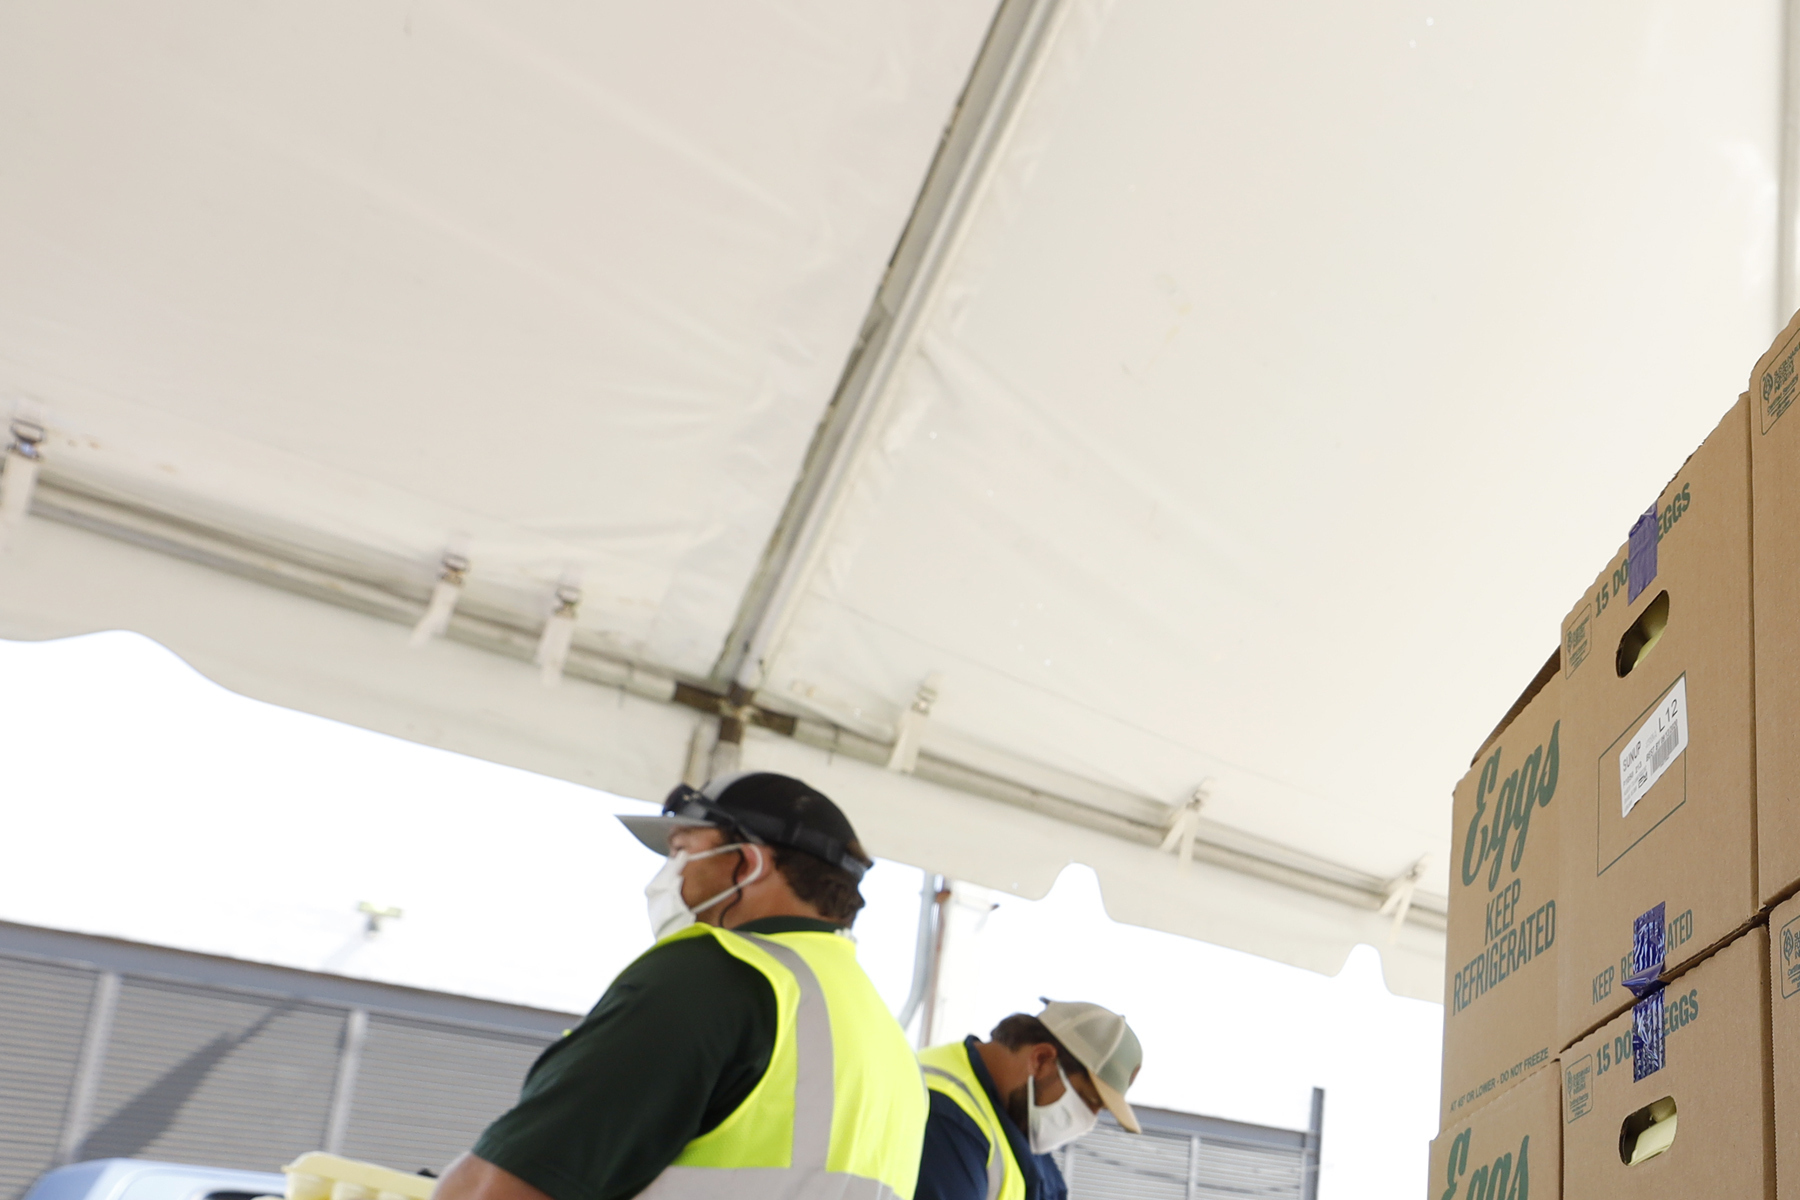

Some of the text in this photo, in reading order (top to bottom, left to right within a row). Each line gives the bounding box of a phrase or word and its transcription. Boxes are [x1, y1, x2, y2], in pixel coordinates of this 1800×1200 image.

[1595, 482, 1691, 618] 15 EGGS
[1461, 719, 1561, 892] Eggs
[1484, 878, 1521, 946] KEEP
[1452, 900, 1556, 1016] REFRIGERATED
[1593, 965, 1614, 1006] KEEP
[1500, 1070, 1510, 1084] DO
[1510, 1061, 1523, 1078] NOT
[1523, 1047, 1549, 1071] FREEZE
[1596, 1042, 1611, 1076] 15
[1664, 989, 1699, 1037] EGGS
